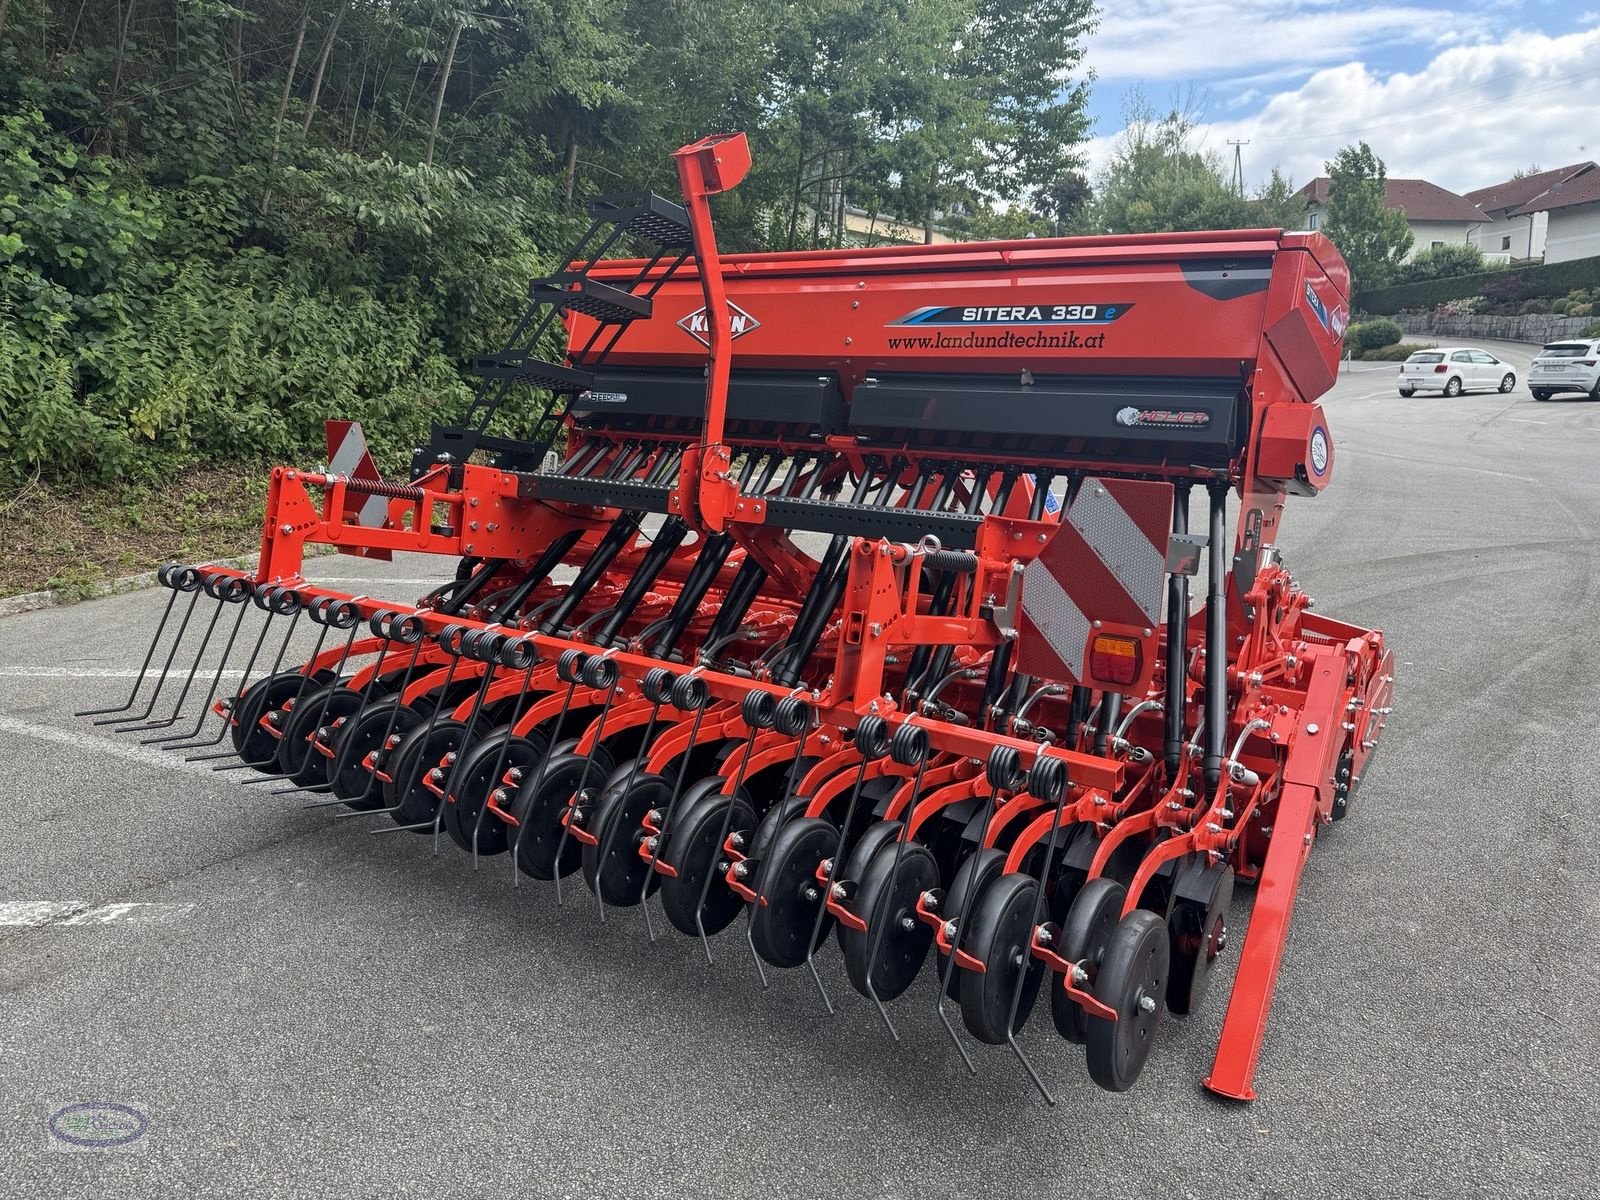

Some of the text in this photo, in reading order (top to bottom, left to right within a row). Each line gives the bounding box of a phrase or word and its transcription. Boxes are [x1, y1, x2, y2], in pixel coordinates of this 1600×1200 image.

[962, 305, 1117, 321] SITERA 330 e
[690, 315, 747, 332] KN
[888, 331, 1105, 349] www.landundtechnik.at
[1138, 410, 1206, 423] HELICA
